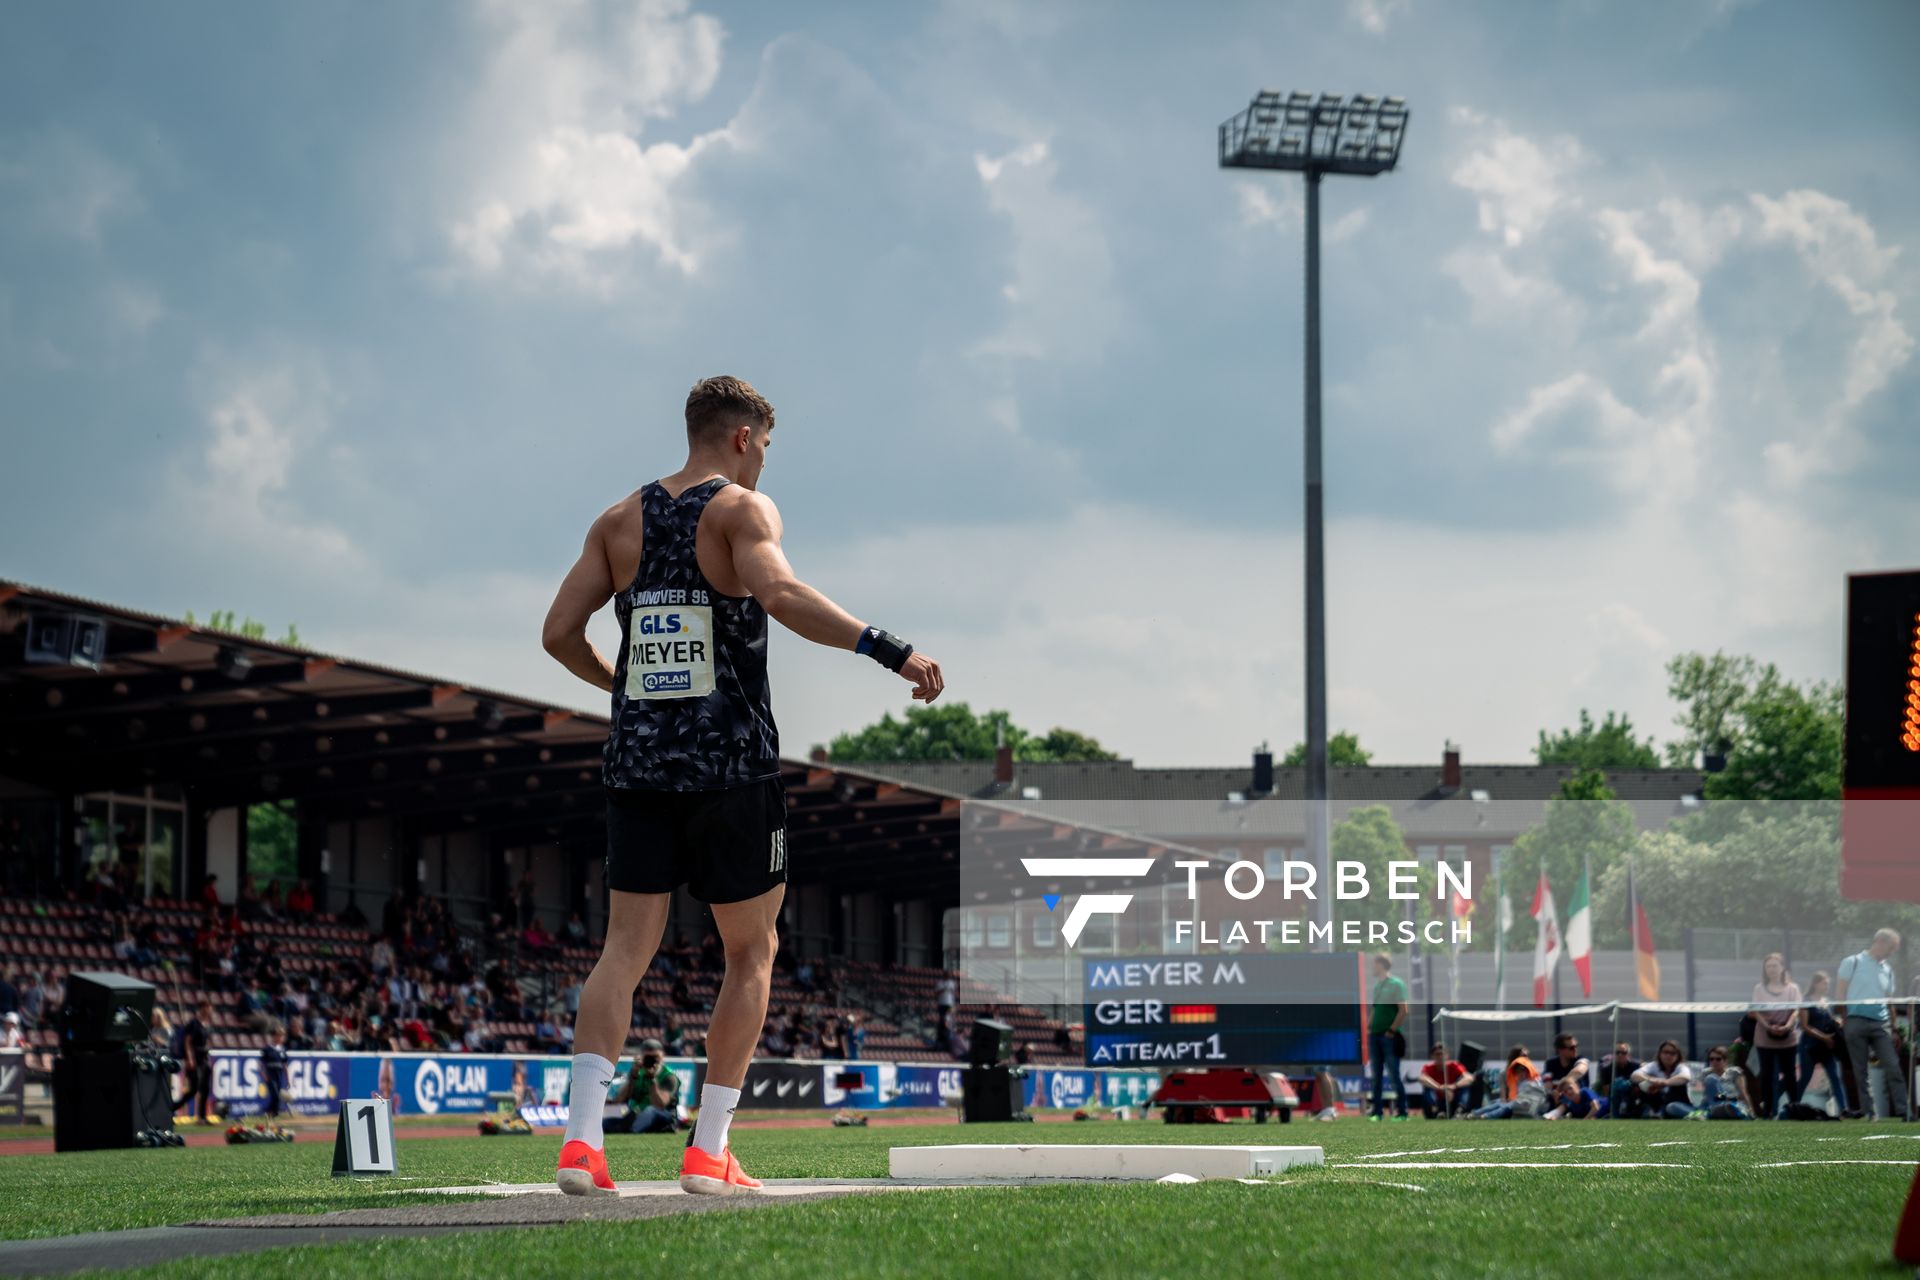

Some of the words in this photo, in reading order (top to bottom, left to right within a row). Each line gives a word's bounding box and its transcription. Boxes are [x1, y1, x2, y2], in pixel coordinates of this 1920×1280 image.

[691, 589, 709, 605] 96
[632, 640, 706, 665] MEYER
[658, 674, 688, 684] PLAN
[1090, 962, 1204, 987] MEYER
[1212, 962, 1246, 985] M
[1094, 1000, 1163, 1025] GER
[1092, 1042, 1203, 1061] ATTEMPT
[1205, 1033, 1227, 1059] 1
[445, 1065, 487, 1093] PLAN
[357, 1106, 380, 1164] 1
